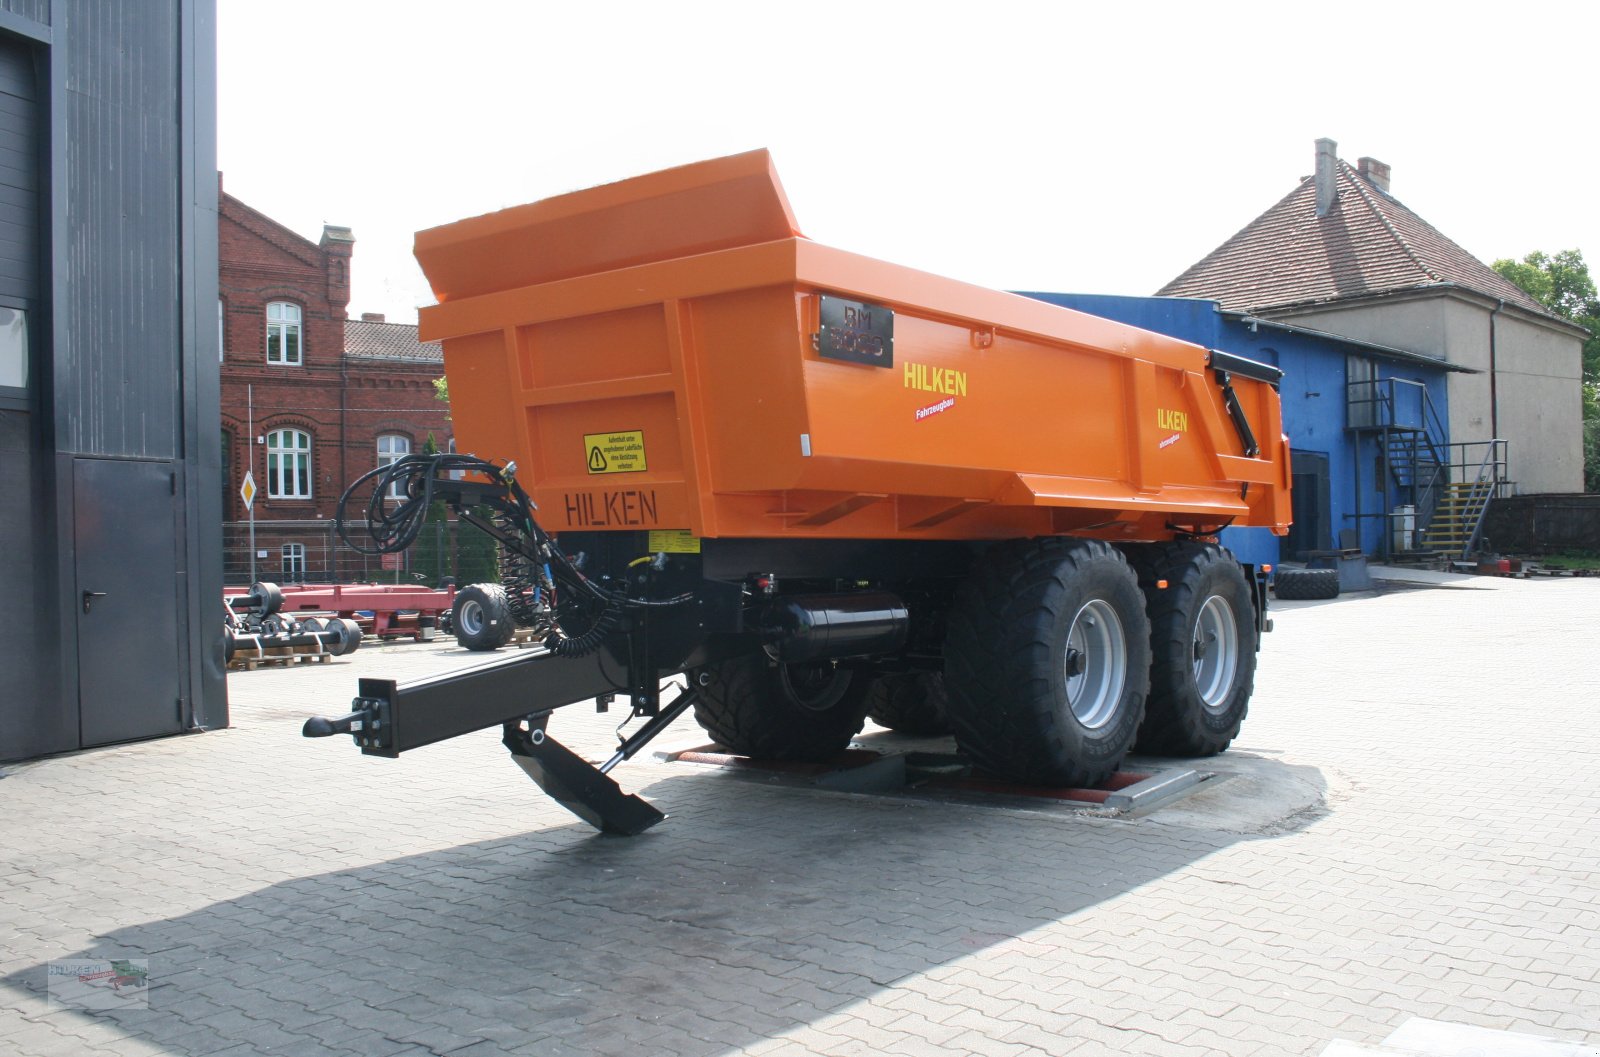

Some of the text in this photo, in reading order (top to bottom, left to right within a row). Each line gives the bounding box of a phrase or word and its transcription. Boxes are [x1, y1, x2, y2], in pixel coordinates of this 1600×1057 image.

[904, 361, 967, 397] HILKEN
[915, 397, 955, 421] Fahrzeugbau
[1157, 408, 1187, 432] ILKEN
[564, 489, 658, 526] HILKEN
